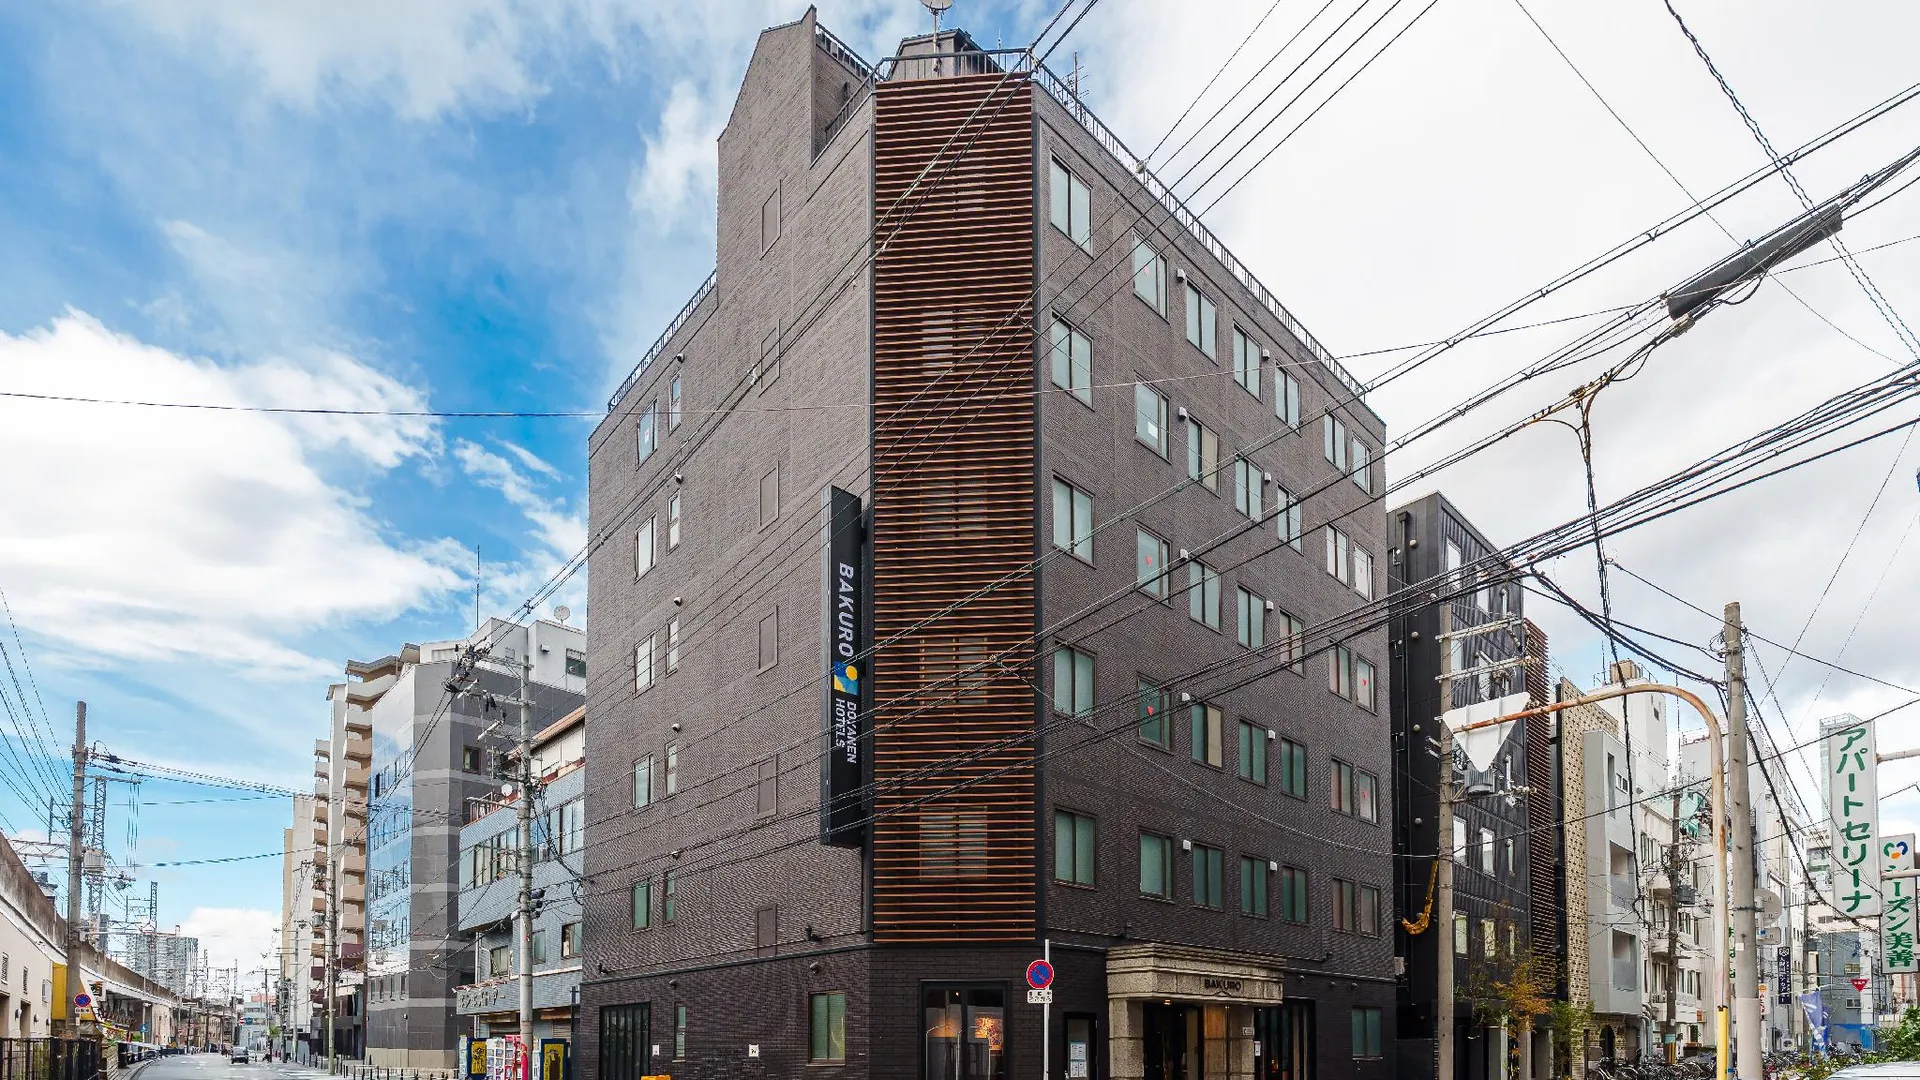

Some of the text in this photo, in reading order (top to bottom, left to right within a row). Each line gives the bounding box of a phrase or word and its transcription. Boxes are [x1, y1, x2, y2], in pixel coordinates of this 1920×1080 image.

[838, 561, 854, 658] BAKURO
[835, 697, 846, 748] HOTELS
[846, 700, 857, 764] DOYANEN
[1836, 726, 1872, 912] アパートセリーナ
[1204, 978, 1242, 991] BAKURO
